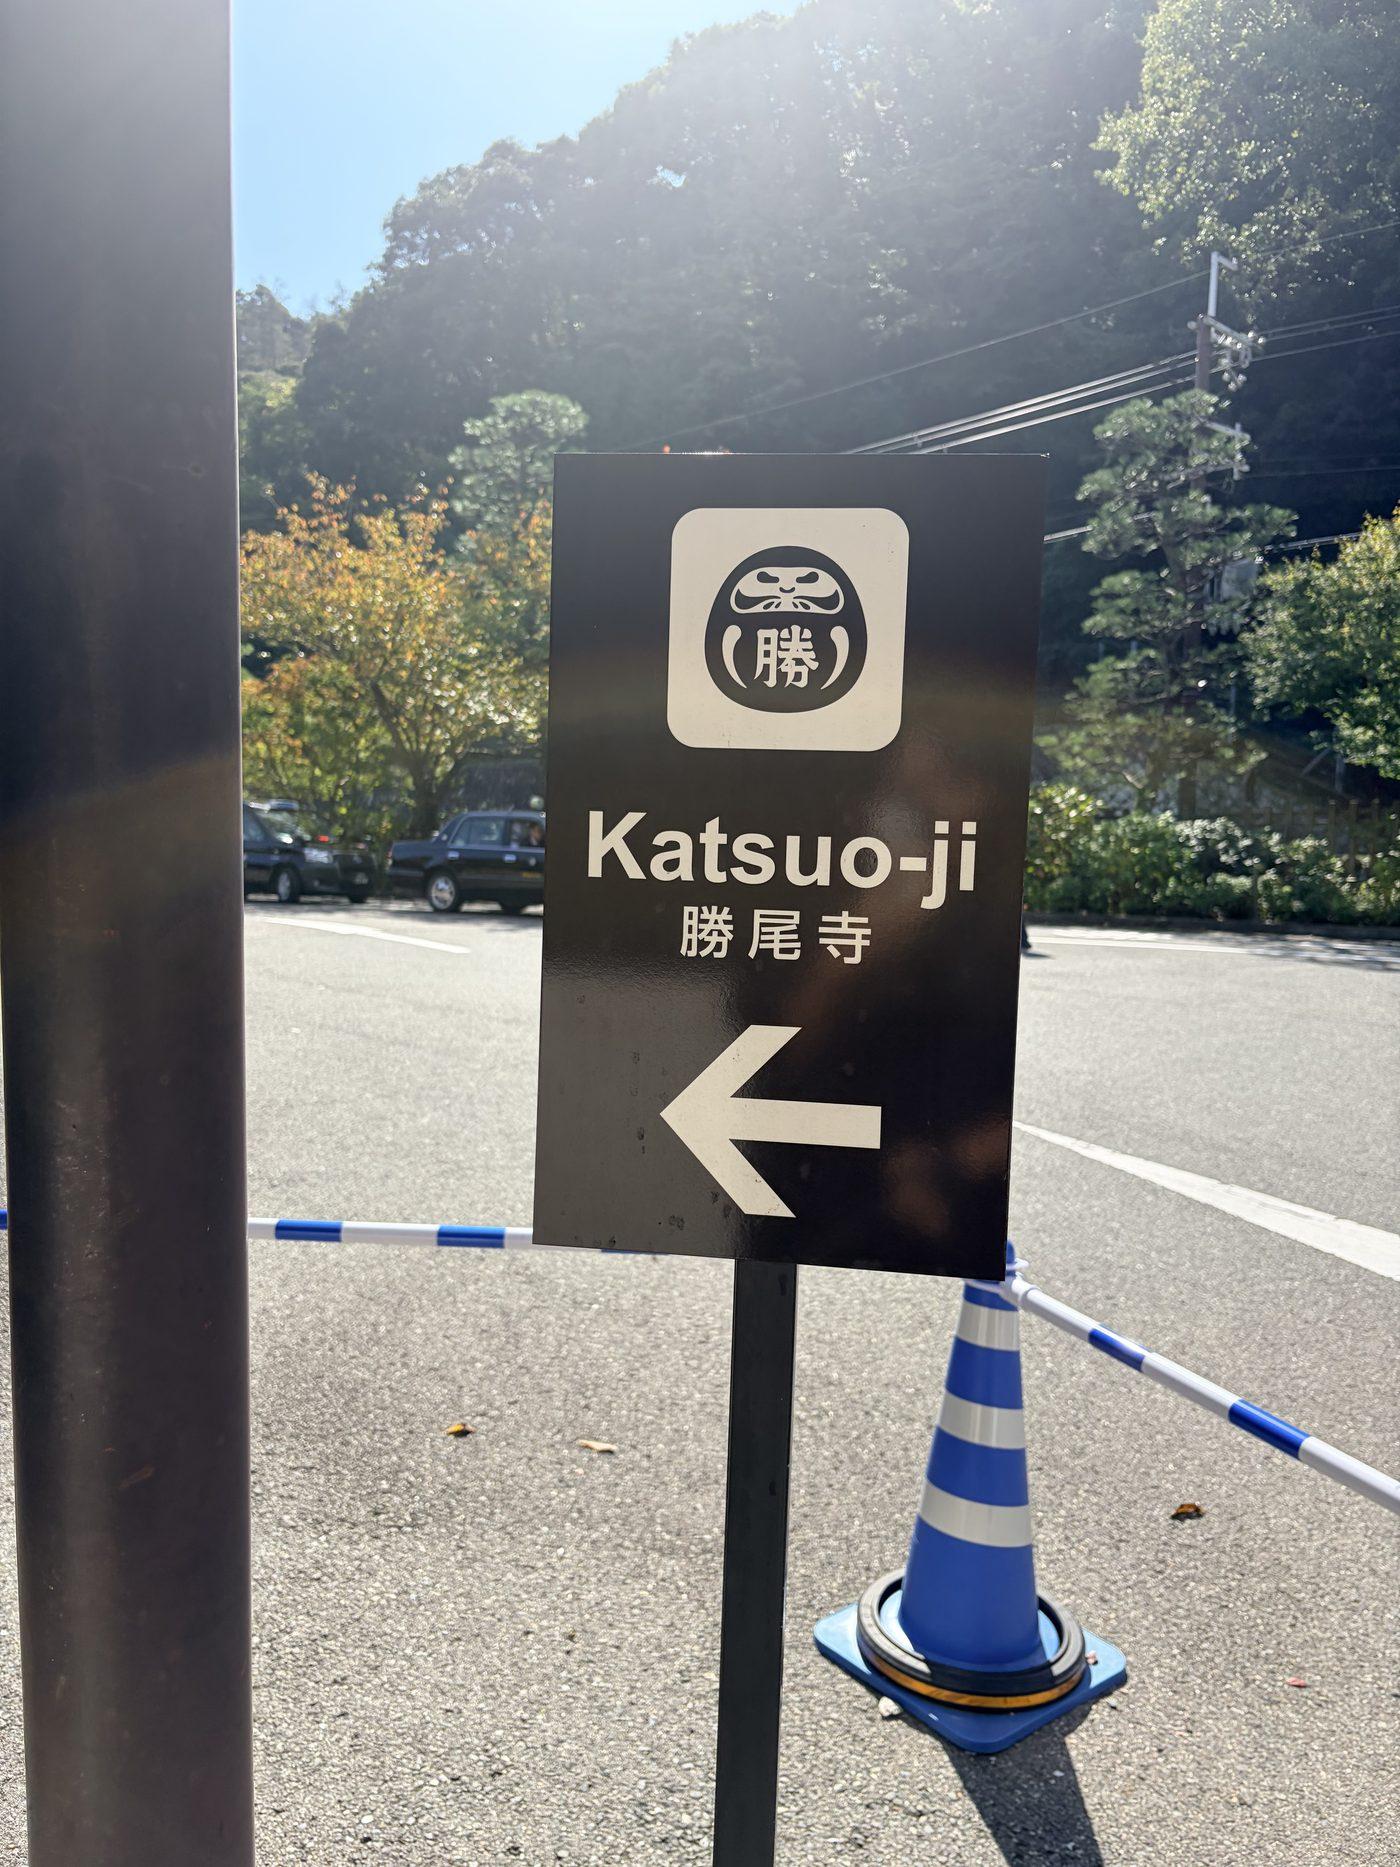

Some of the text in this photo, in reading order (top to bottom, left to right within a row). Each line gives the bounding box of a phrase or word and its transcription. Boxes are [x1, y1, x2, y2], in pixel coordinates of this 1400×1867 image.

[753, 624, 819, 688] 勝
[587, 810, 977, 910] Katsuo-ji
[679, 905, 872, 965] 勝尾寺
